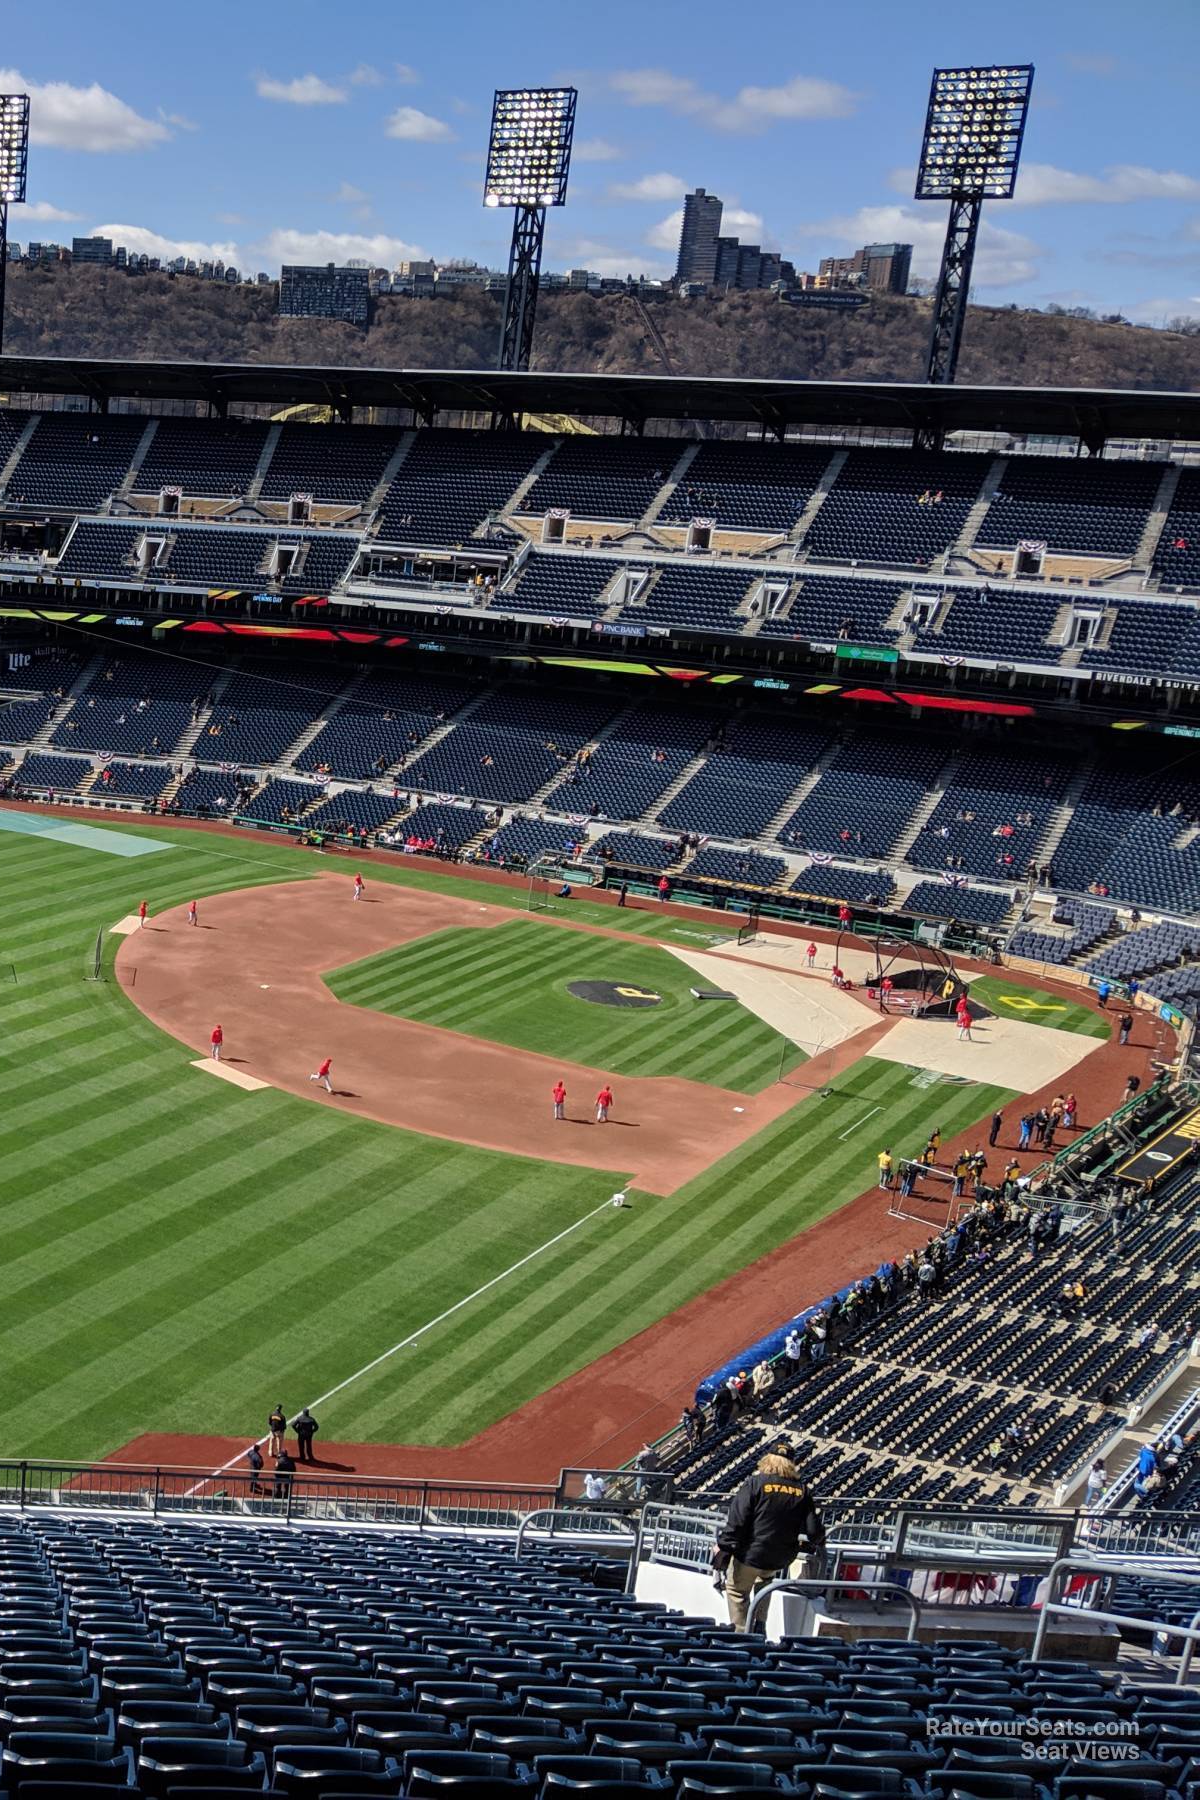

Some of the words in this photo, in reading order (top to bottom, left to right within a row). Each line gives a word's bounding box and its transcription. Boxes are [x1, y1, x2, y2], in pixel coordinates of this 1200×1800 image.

[603, 624, 620, 632] PNC
[621, 626, 642, 634] BANK
[8, 653, 31, 672] Lite
[1096, 672, 1153, 686] RIVENDALE
[764, 1484, 802, 1496] STAFF
